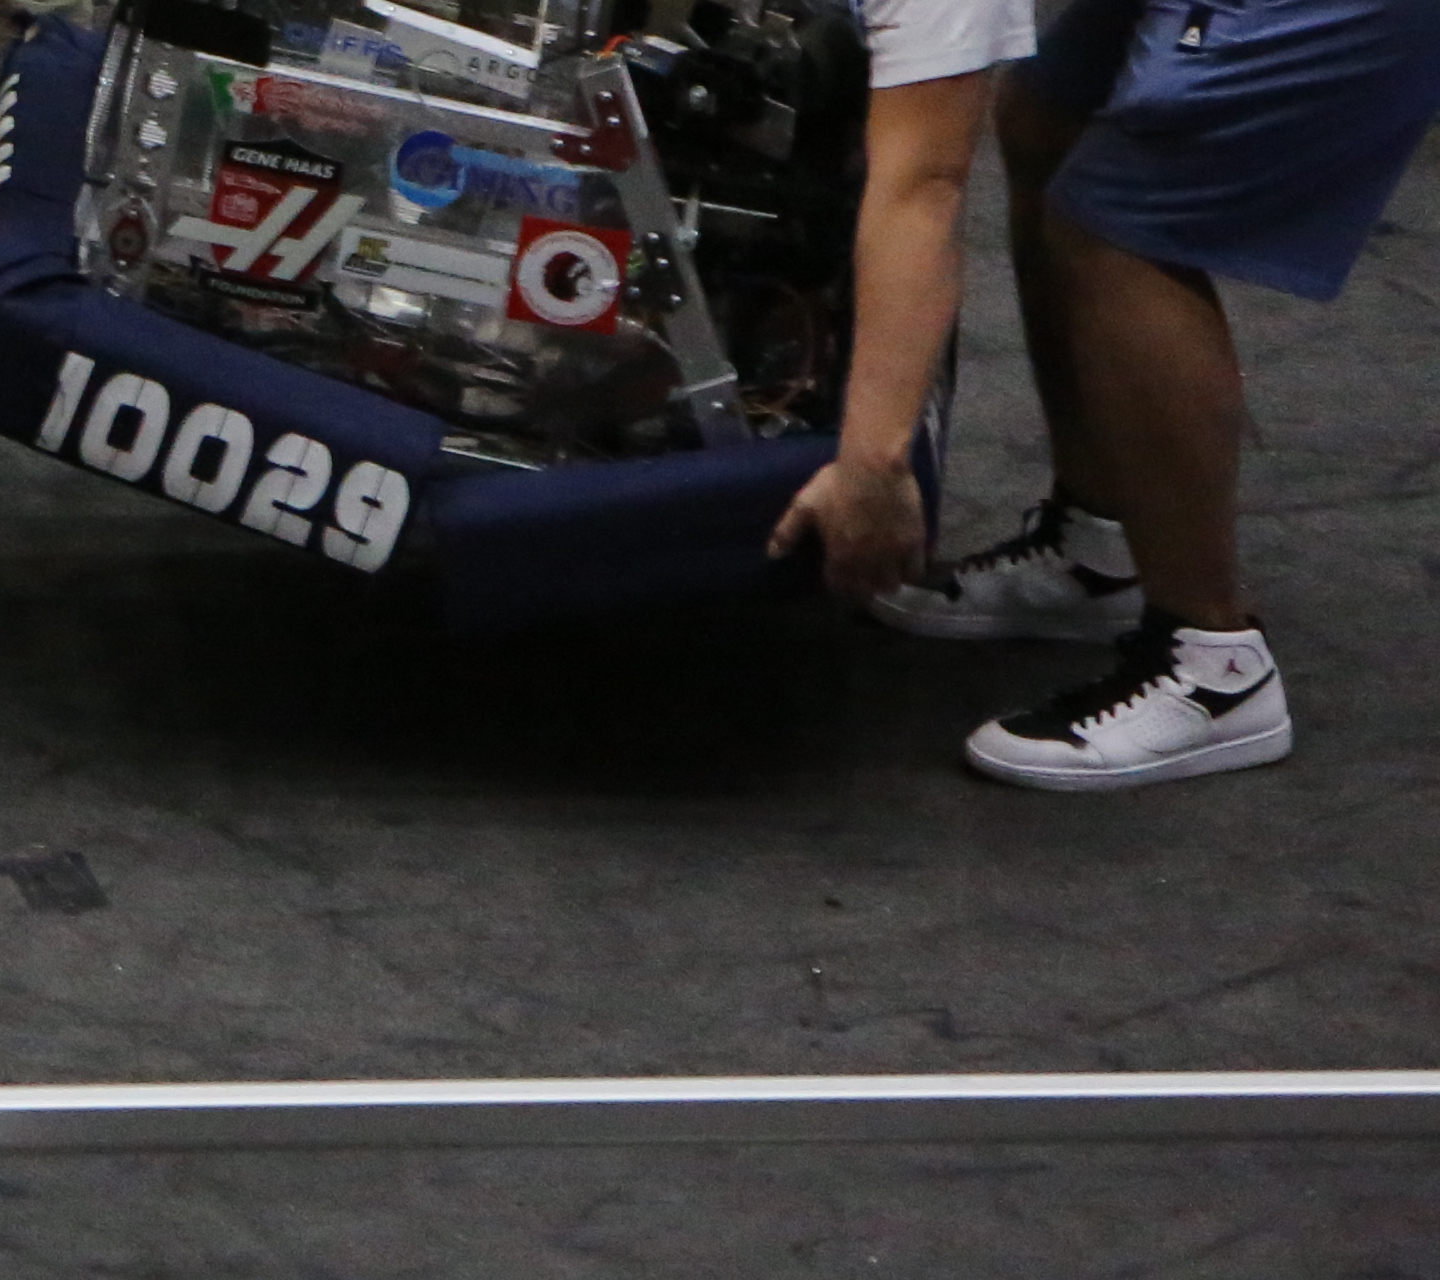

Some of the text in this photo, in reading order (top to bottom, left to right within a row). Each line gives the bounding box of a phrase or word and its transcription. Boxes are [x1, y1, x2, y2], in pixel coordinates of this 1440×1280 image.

[231, 147, 336, 180] GENE HAAS
[35, 350, 410, 575] 10029
